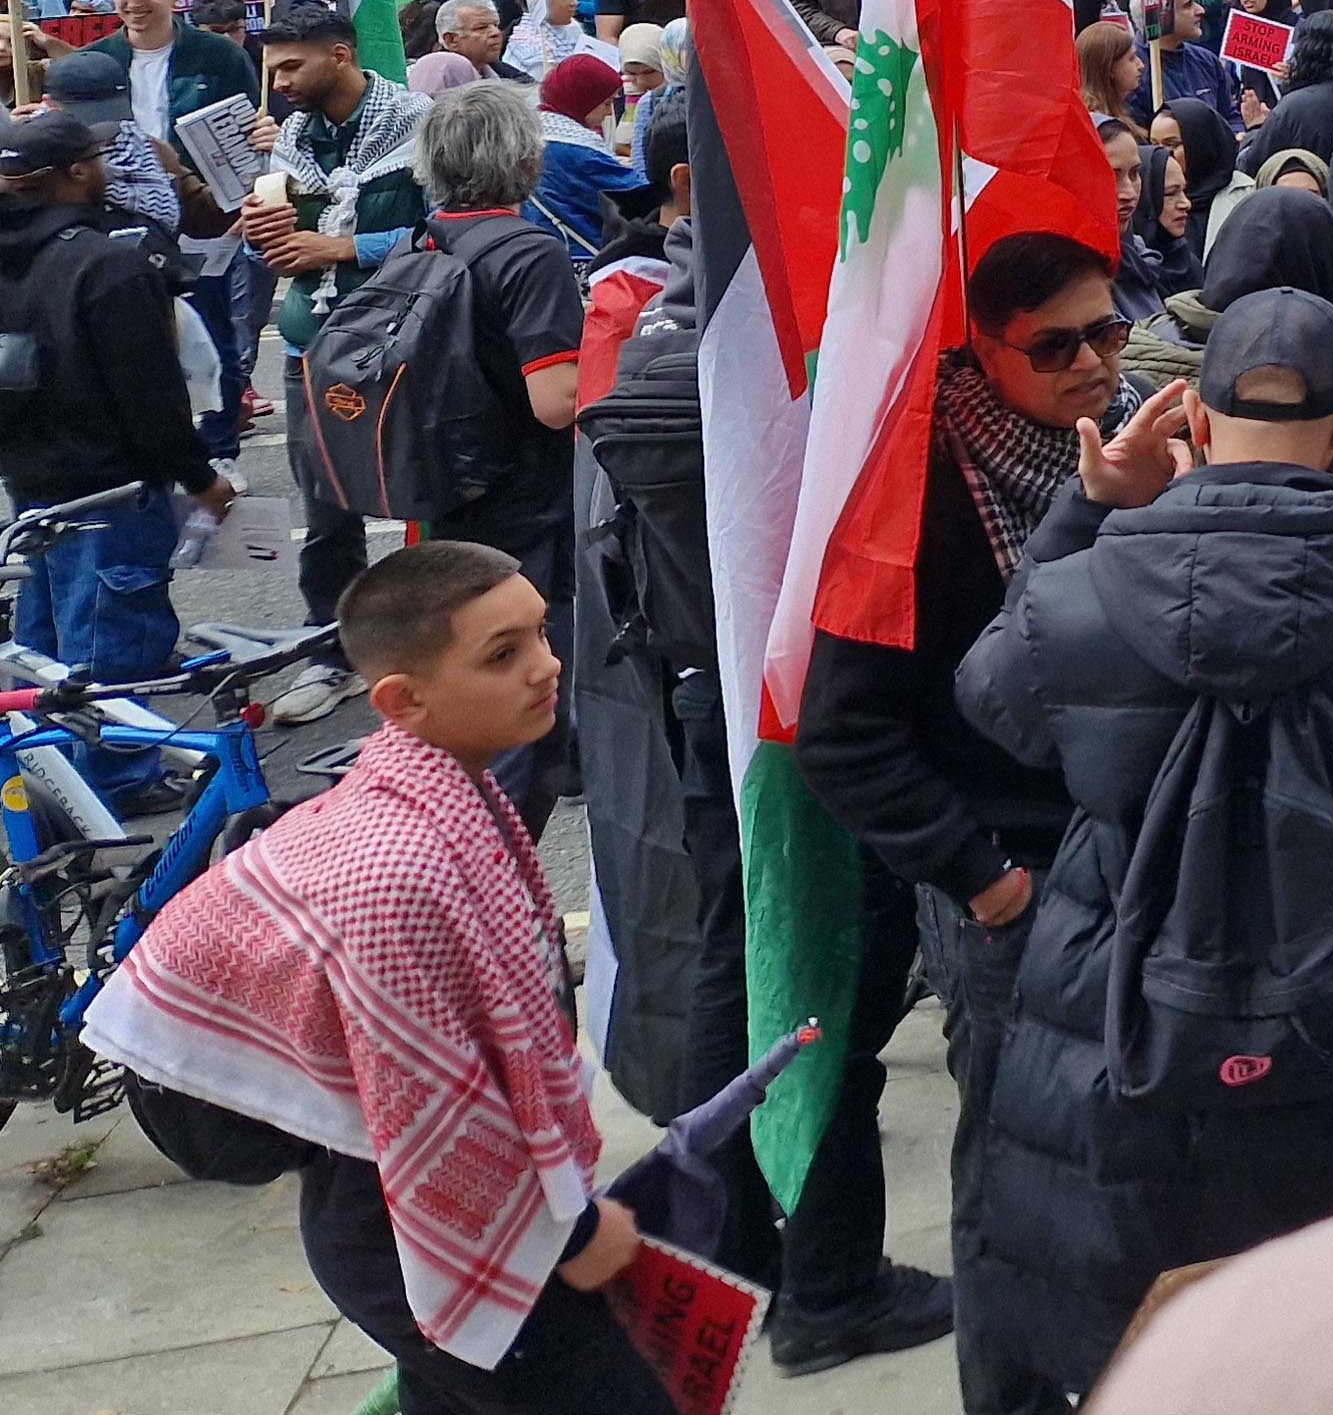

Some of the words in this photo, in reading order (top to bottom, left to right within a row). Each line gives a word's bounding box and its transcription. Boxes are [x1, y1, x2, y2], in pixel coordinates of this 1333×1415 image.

[1243, 20, 1275, 38] STOP
[1232, 33, 1281, 55] ARMING
[1233, 44, 1273, 66] ISRAEL
[23, 753, 92, 835] RIDGEBACK
